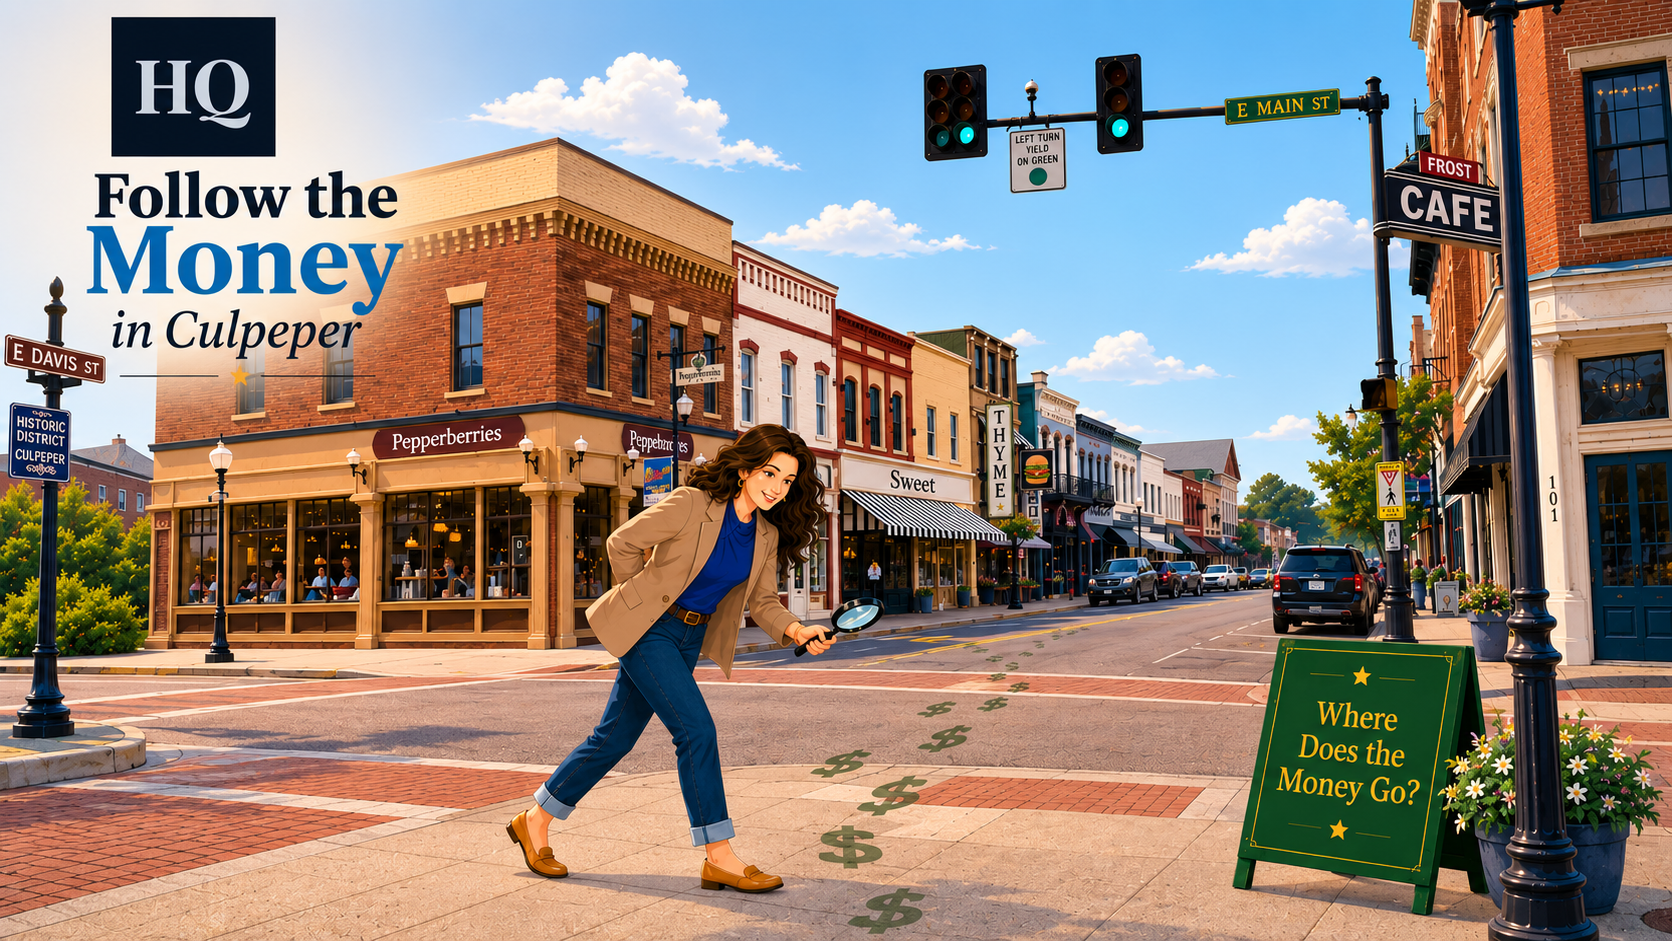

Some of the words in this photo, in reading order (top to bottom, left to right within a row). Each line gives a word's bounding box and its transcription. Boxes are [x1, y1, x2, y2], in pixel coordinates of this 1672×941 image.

[1237, 102, 1248, 118] E
[1257, 97, 1304, 116] MAIN
[1312, 96, 1330, 111] ST
[1015, 134, 1034, 144] LEFT
[1038, 132, 1060, 142] TURN
[1026, 144, 1049, 154] YIELD
[1017, 157, 1029, 166] ON
[1032, 154, 1058, 165] GREEN
[1428, 156, 1472, 179] FROST
[1400, 184, 1494, 232] CAFE
[13, 343, 24, 361] E
[32, 347, 77, 372] DAVIS
[84, 361, 100, 375] ST
[17, 415, 66, 433] HISTORIC
[17, 430, 66, 447] DISTRICT
[392, 425, 502, 454] Pepperberries
[15, 449, 66, 465] CULPEPER
[993, 409, 1008, 499] THYME
[890, 469, 936, 494] Sweet
[1549, 475, 1559, 523] 101
[1317, 701, 1398, 732] Where
[1298, 733, 1359, 763] Does
[1366, 739, 1405, 767] the
[1276, 766, 1363, 806] Money
[1370, 776, 1421, 806] Go?
